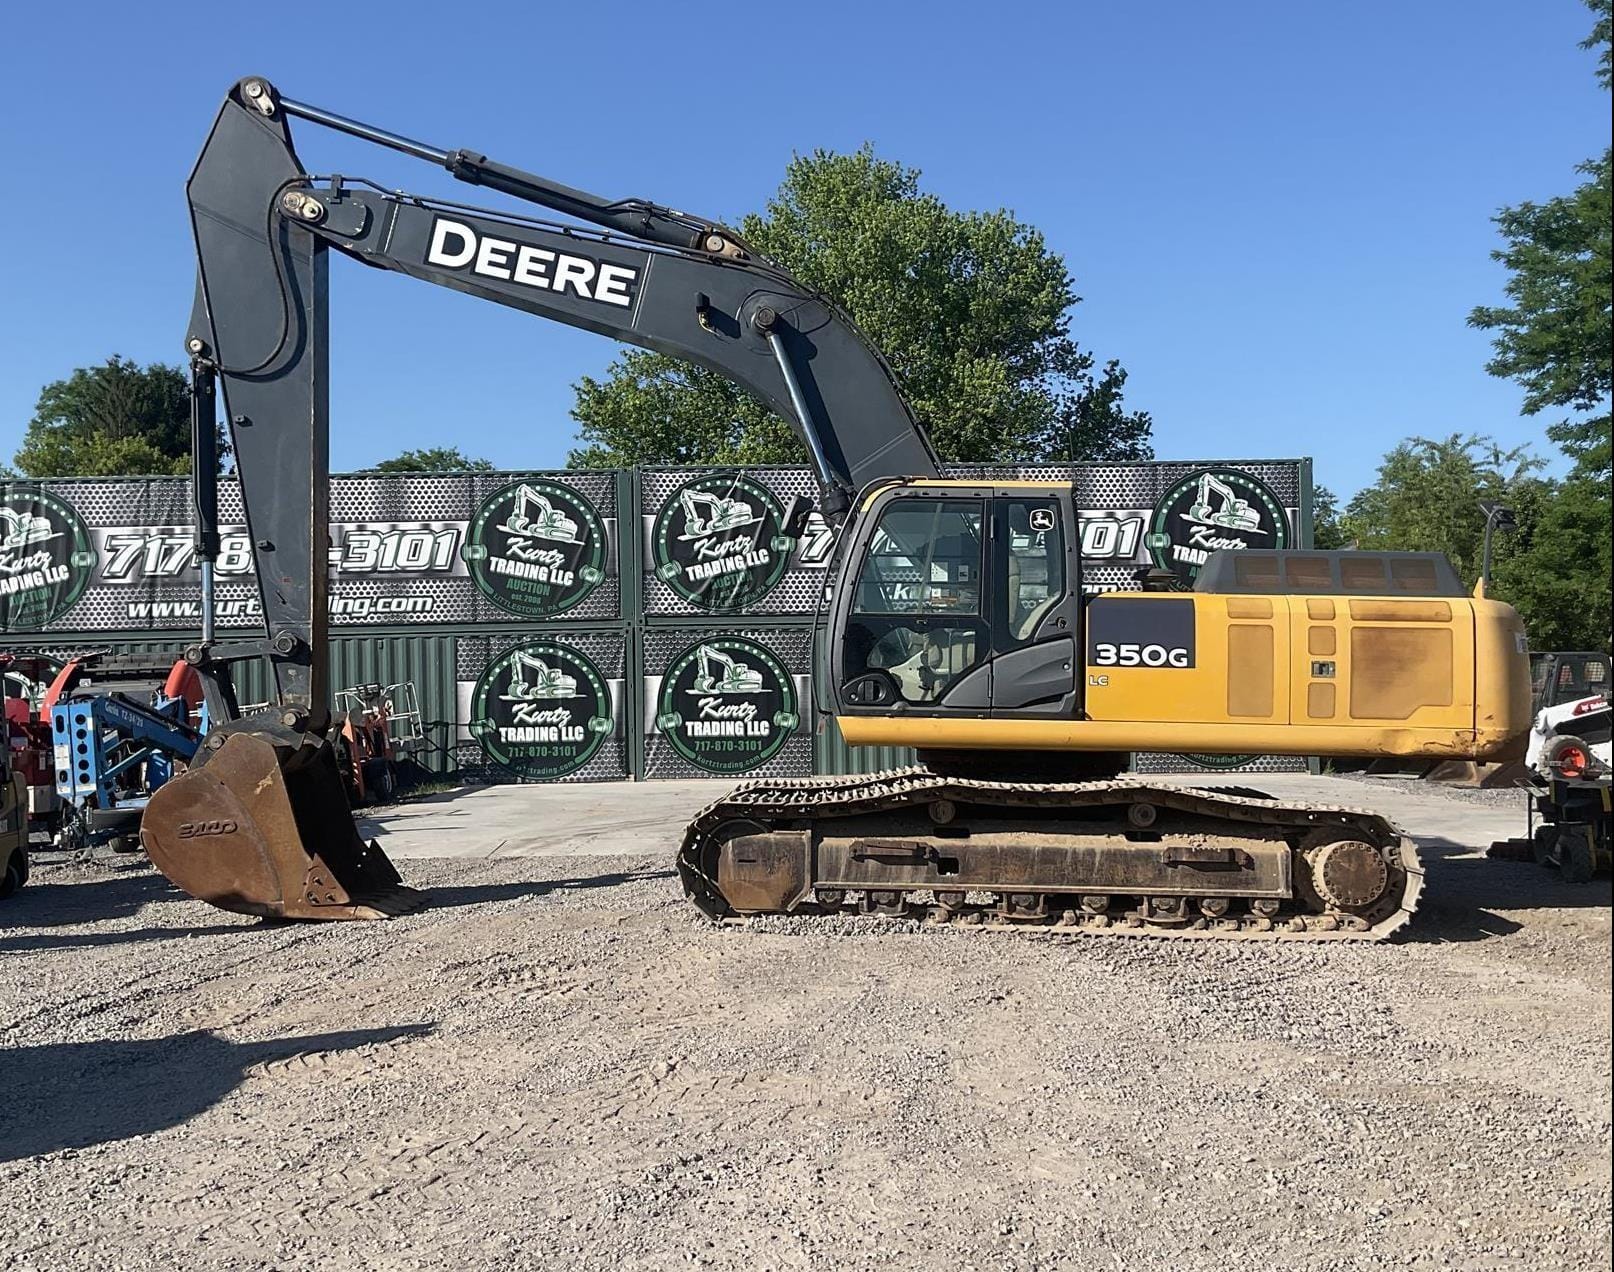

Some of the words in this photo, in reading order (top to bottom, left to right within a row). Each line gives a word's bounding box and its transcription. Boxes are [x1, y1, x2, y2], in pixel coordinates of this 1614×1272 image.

[427, 217, 637, 307] DEERE
[508, 537, 565, 570] Kurtz
[694, 535, 753, 561] Kurtz
[1173, 544, 1209, 566] TRAD
[490, 556, 549, 583] TRADING
[549, 569, 574, 586] LLC
[685, 554, 747, 582] TRADING
[746, 548, 769, 567] LLC
[0, 571, 44, 595] ADING
[45, 564, 70, 584] LLC
[506, 578, 551, 596] AUCTION
[1095, 643, 1189, 667] 350G
[1088, 675, 1109, 687] LC
[511, 703, 572, 729] Kurtz
[698, 697, 758, 723] Kurtz
[499, 726, 559, 742] TRADING
[560, 725, 585, 741] LLC
[685, 720, 745, 737] TRADING
[746, 720, 770, 737] LLC
[508, 746, 577, 757] 717-870-3101
[694, 740, 763, 752] 717-870-3101
[696, 755, 761, 769] kurtztrading.com
